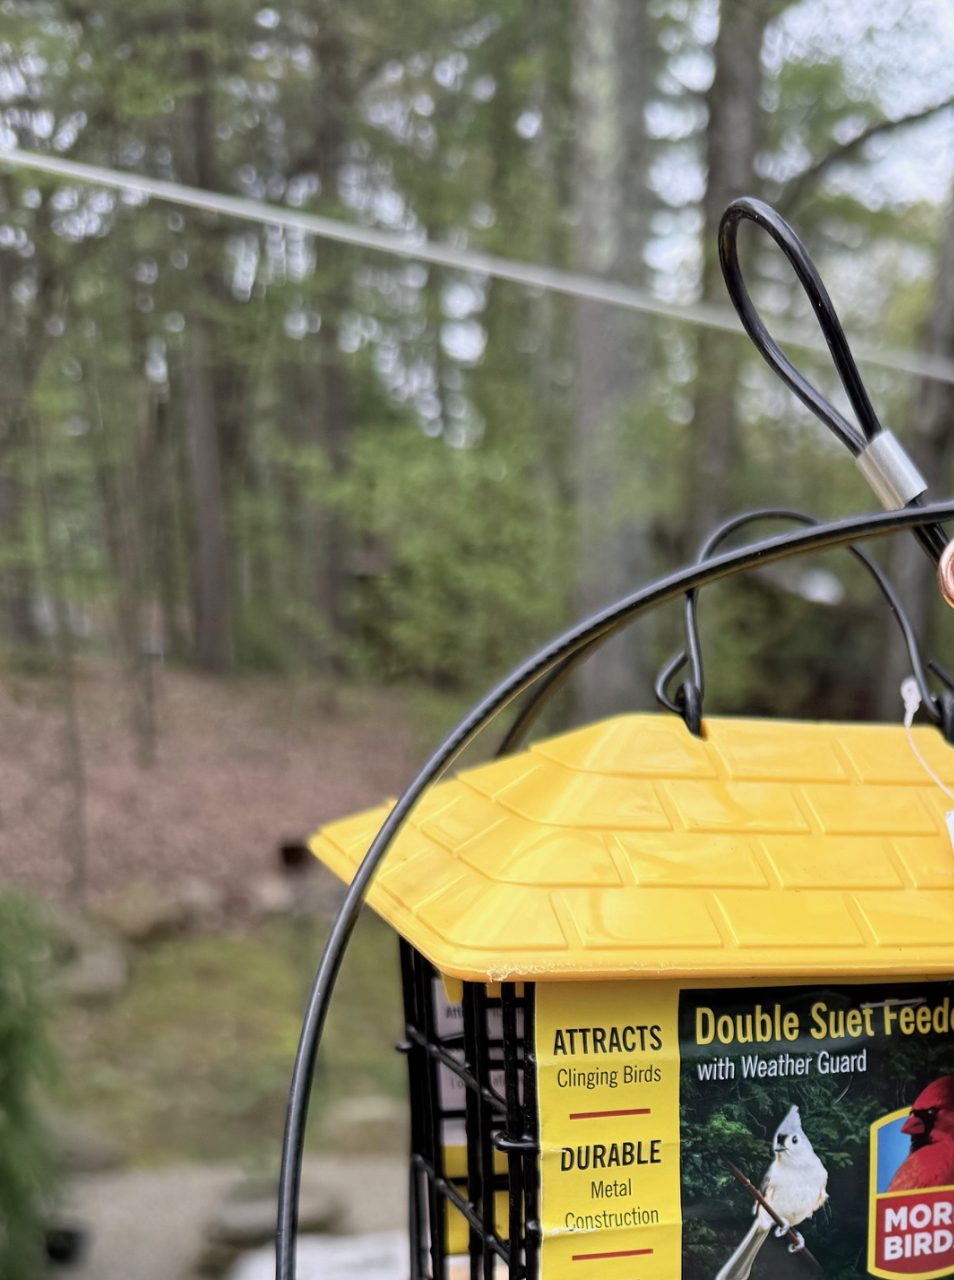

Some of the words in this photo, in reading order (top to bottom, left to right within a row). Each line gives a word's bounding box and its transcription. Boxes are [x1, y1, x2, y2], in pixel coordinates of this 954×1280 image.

[695, 1004, 800, 1045] Double
[811, 1002, 875, 1040] Suet
[553, 1025, 662, 1056] ATTRACTS
[557, 1066, 619, 1089] Clinging
[623, 1064, 662, 1084] Birds
[697, 1056, 735, 1081] with
[741, 1056, 813, 1079] Weather
[817, 1049, 867, 1076] Guard
[560, 1139, 662, 1172] DURABLE
[591, 1178, 632, 1199] Metal
[565, 1206, 660, 1232] Construction
